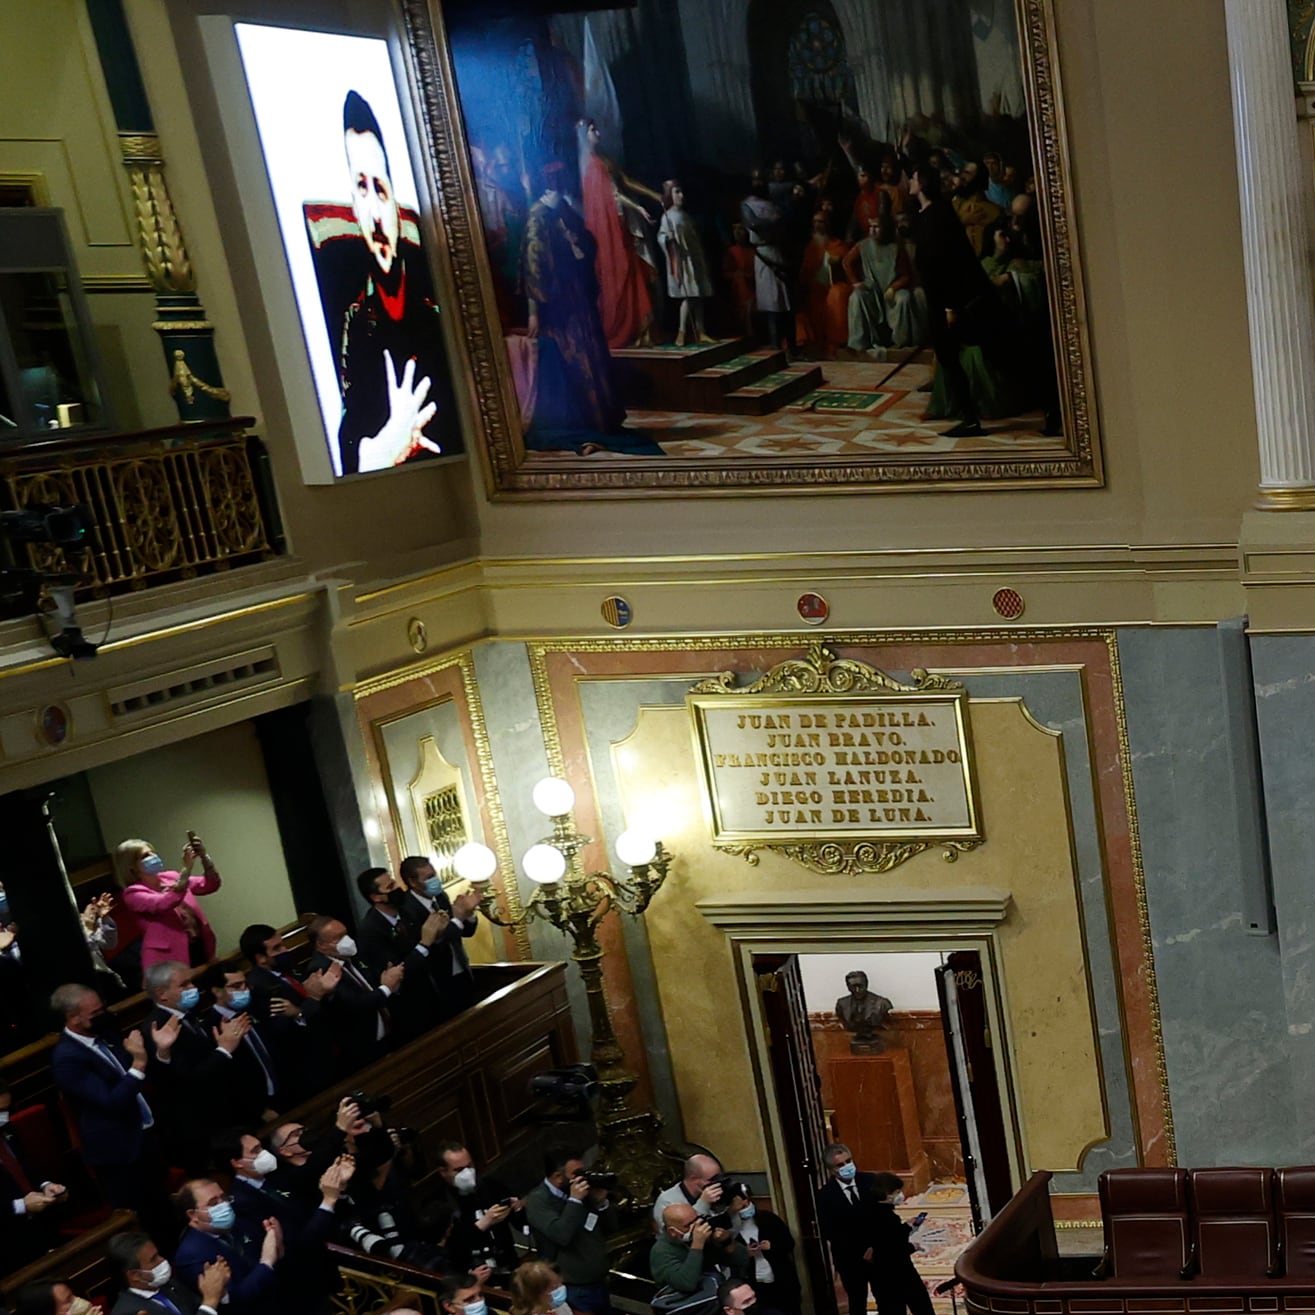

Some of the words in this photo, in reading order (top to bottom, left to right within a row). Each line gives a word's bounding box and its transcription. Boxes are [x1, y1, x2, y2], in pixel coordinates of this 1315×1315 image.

[737, 714, 791, 729] JUAN
[799, 714, 827, 728] DE
[834, 712, 936, 728] PADILLA.
[767, 732, 821, 748] JUAN
[828, 732, 907, 747] BRAVO.
[714, 751, 826, 767] FRANCISCO
[760, 771, 817, 786] JUAN
[828, 769, 922, 785] LANUZA.
[755, 790, 823, 805] DIEGO
[832, 788, 935, 804] HEREDIA.
[765, 809, 822, 824] JUAN
[832, 809, 861, 823] DE
[869, 807, 932, 822] LUNA.
